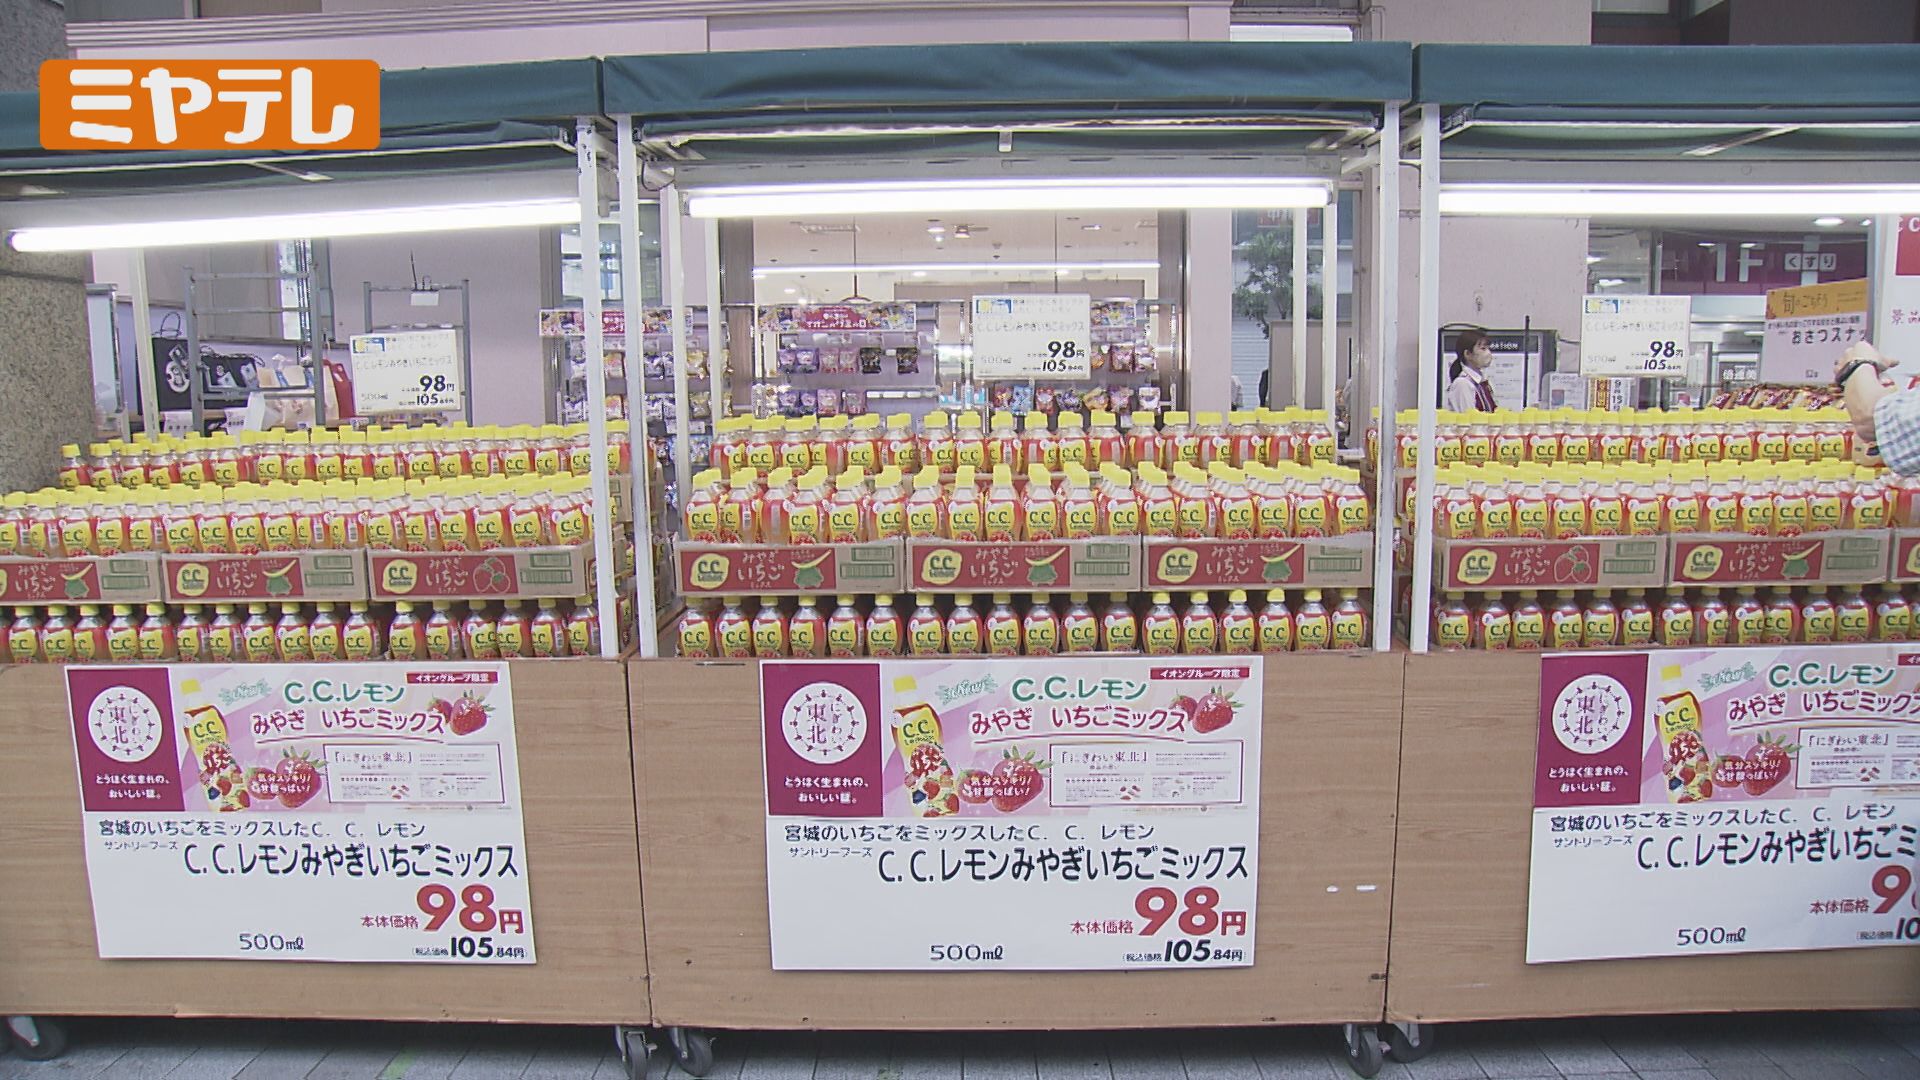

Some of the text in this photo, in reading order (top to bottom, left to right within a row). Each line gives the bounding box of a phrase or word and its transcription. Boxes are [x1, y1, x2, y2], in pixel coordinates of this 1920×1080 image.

[1786, 253, 1835, 270] くすり
[737, 564, 785, 582] いちご
[970, 560, 1019, 578] いちご
[1205, 557, 1254, 576] いちご
[1504, 559, 1550, 577] いちご
[1729, 555, 1775, 573] いちご
[15, 576, 56, 593] いちご
[217, 574, 257, 590] いちご
[426, 570, 468, 588] いちご
[1769, 662, 1895, 688] C.C.レモン
[284, 680, 405, 704] C.C.レモン
[1012, 676, 1148, 702] C.C.レモン
[1729, 693, 1786, 721] みやぎ
[253, 707, 445, 736] みやぎ いちごミックス
[807, 703, 828, 745] 東北
[971, 705, 1186, 736] みやぎ いちごミックス
[104, 840, 179, 851] サントリーフーズ
[1553, 834, 1634, 848] サントリーフーズ
[183, 842, 519, 877] C.C.レモンみやぎいちごミックス
[788, 847, 873, 858] サントリーフーズ
[878, 845, 1248, 882] C.C.レモンみやぎいちごミックス
[1809, 864, 1919, 915] 本体価格 9
[360, 883, 525, 935] 本体価格 98円
[1069, 886, 1247, 936] 本体価格 98円
